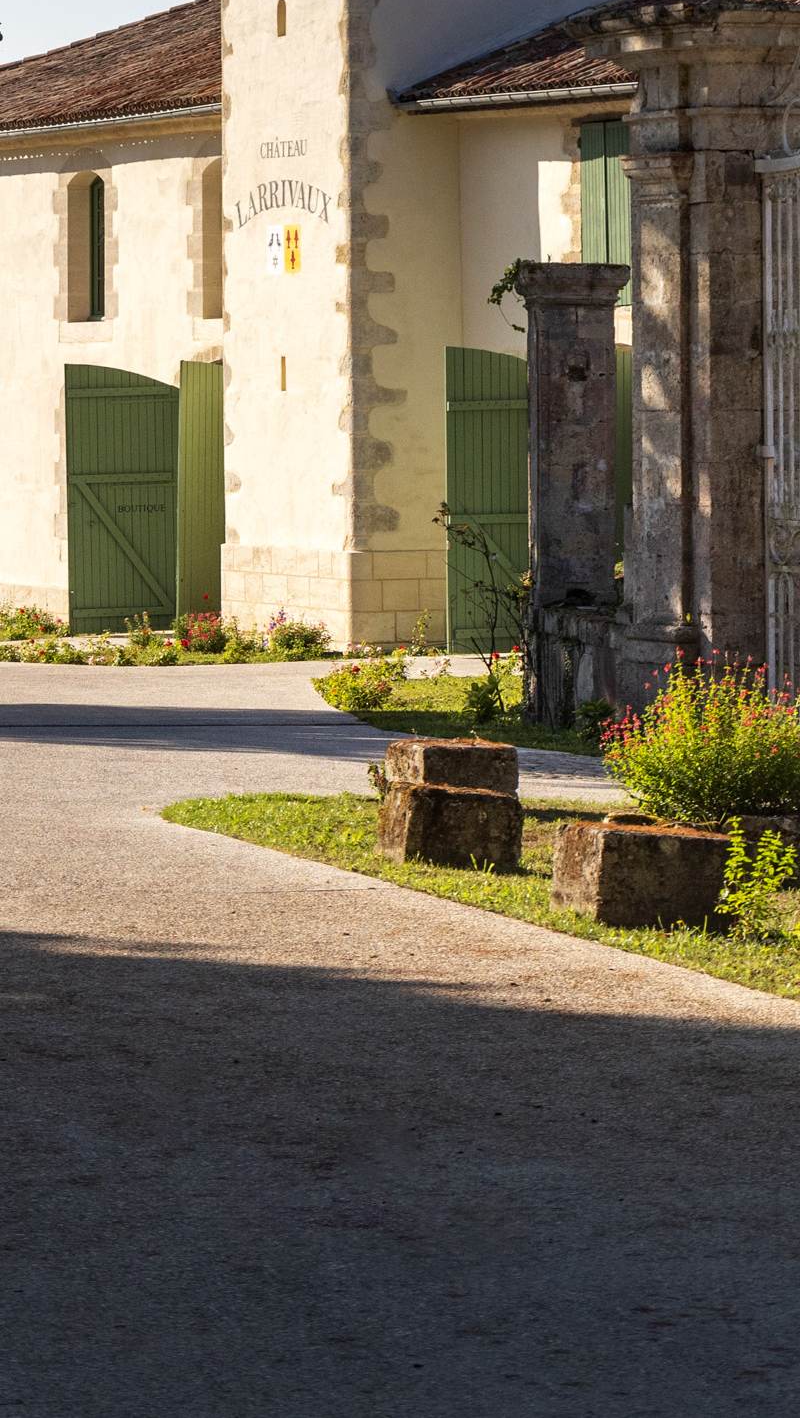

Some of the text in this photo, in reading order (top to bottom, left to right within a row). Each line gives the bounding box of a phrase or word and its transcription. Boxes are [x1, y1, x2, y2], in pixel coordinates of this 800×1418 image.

[260, 136, 308, 159] CHÂTEAU
[234, 179, 332, 229] LARRIVAUX
[118, 503, 167, 513] BOUTIQUE
